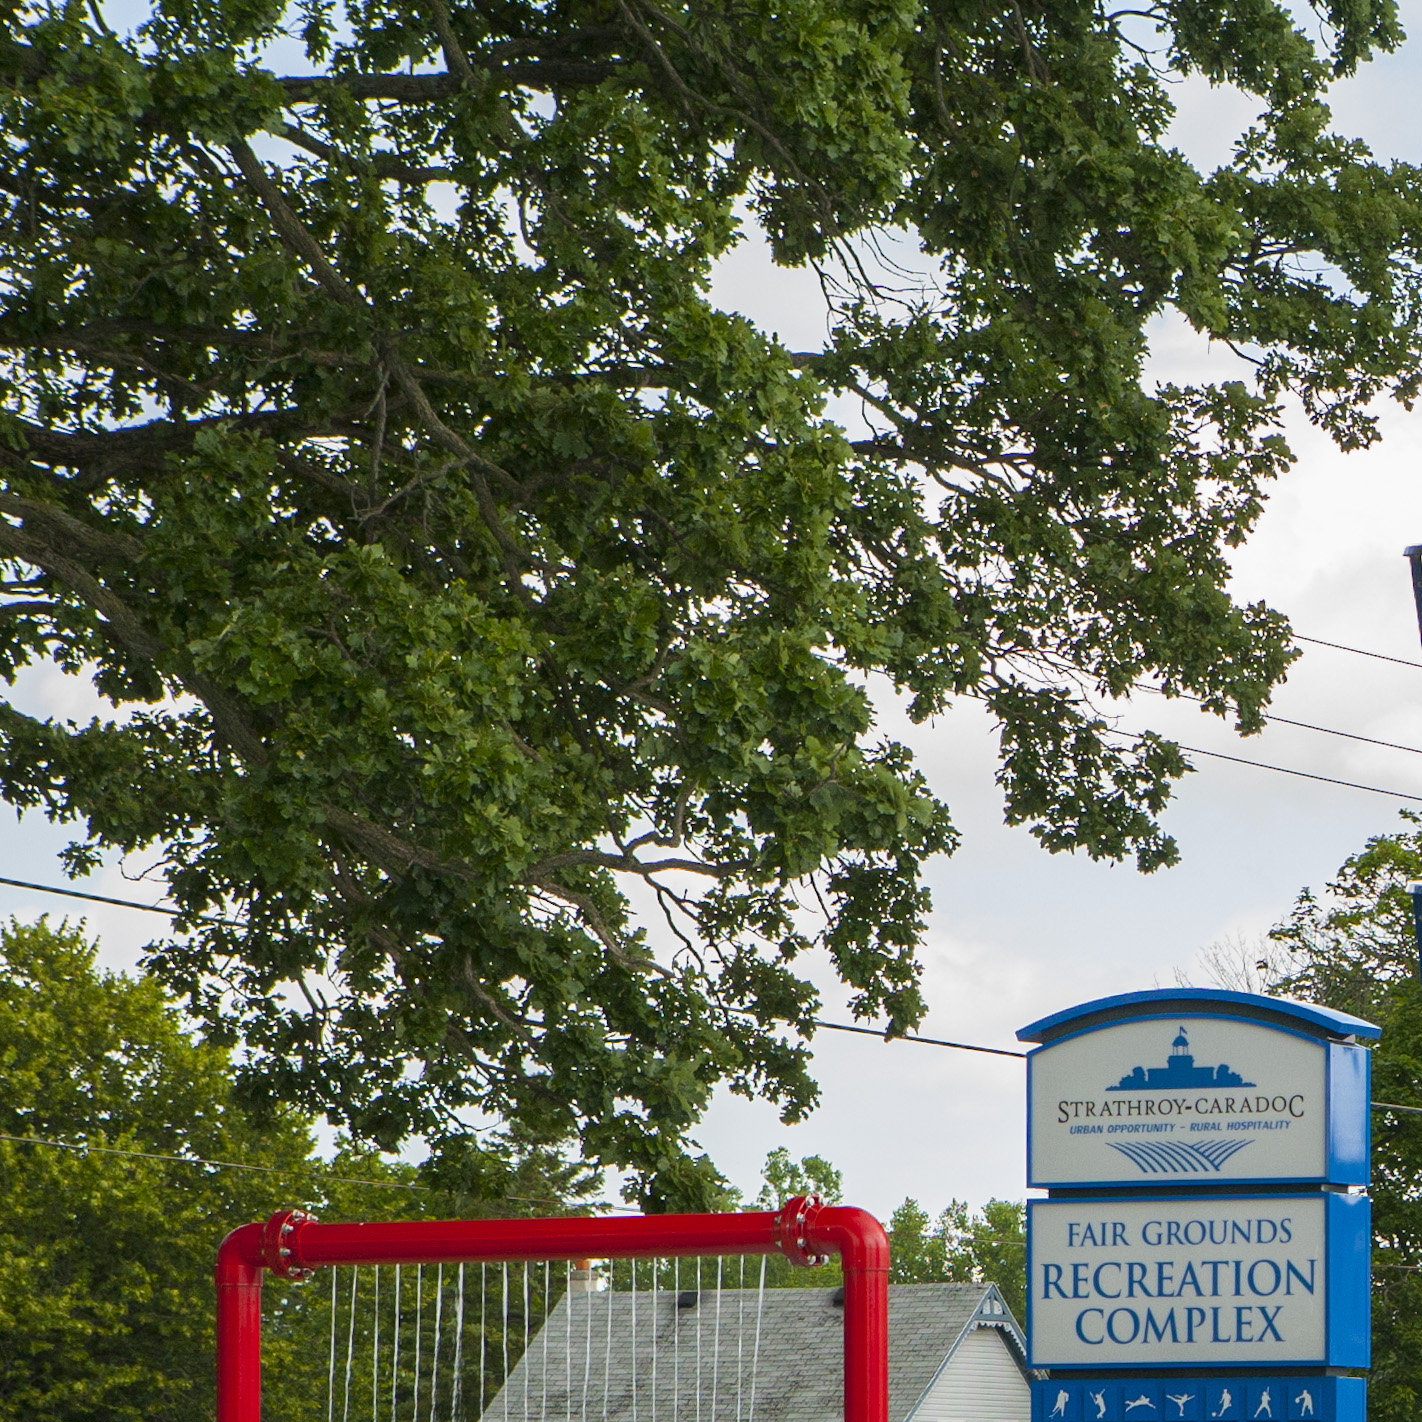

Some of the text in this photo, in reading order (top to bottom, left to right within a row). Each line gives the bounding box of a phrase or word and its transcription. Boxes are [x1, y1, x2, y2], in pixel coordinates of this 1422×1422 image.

[1058, 1094, 1305, 1124] STRATHROY-CARADOC
[1070, 1124, 1103, 1135] URBAN
[1107, 1122, 1175, 1134] OPPORTUNITY
[1190, 1121, 1223, 1132] RURAL
[1226, 1119, 1292, 1131] HOSPITALITY
[1067, 1218, 1293, 1248] FAIR GROUNDS
[1041, 1259, 1318, 1300] RECREATION
[1075, 1305, 1286, 1345] COMPLEX
